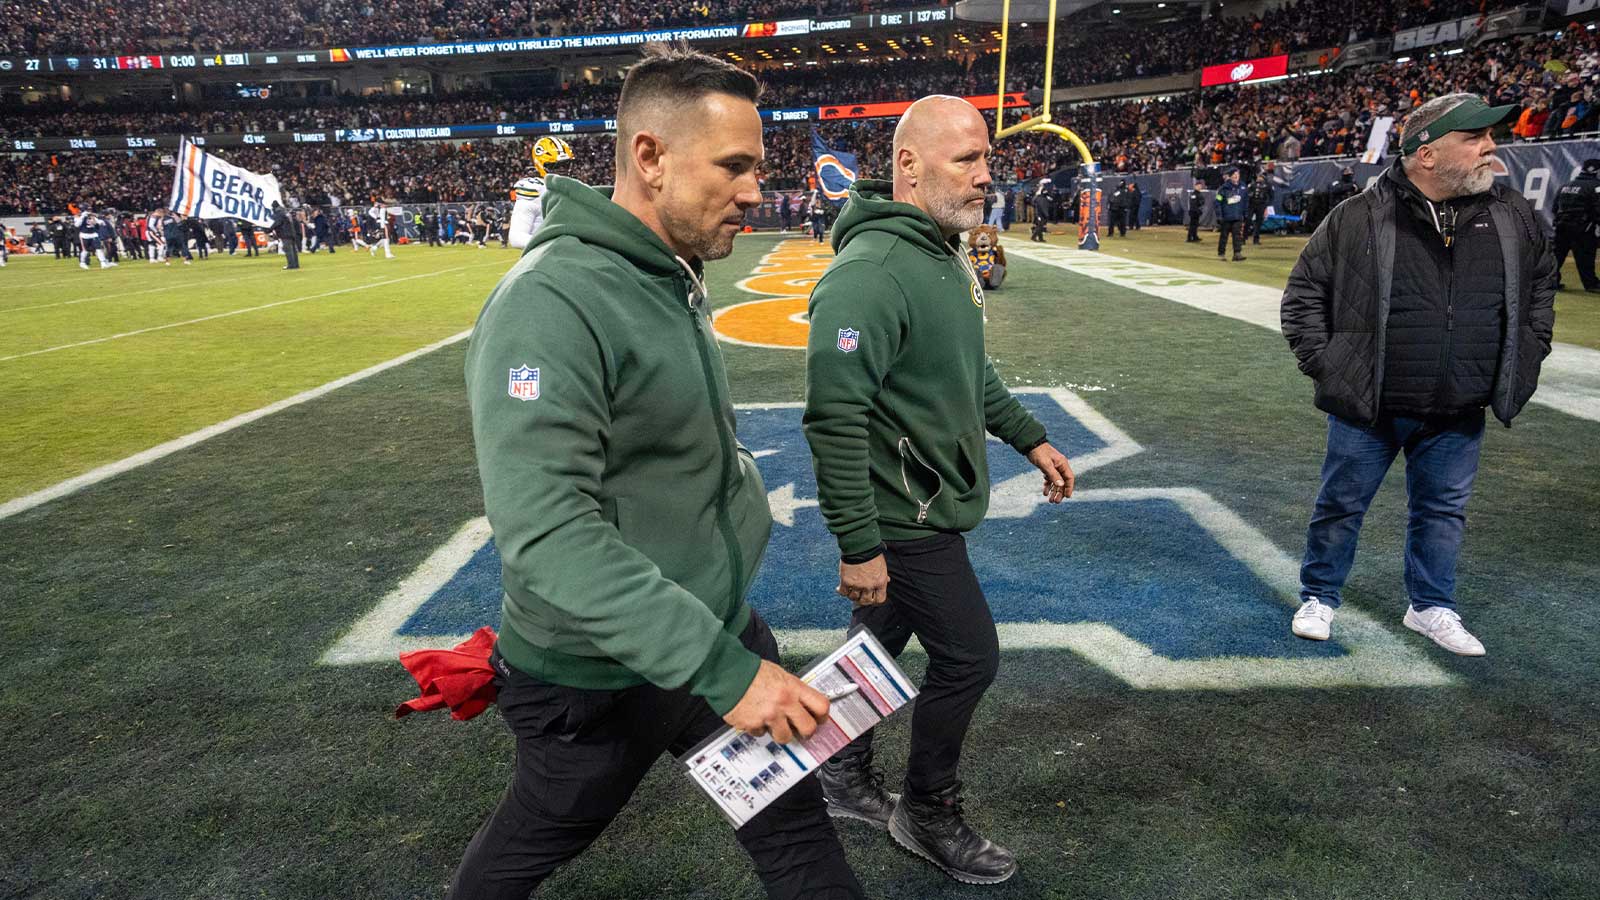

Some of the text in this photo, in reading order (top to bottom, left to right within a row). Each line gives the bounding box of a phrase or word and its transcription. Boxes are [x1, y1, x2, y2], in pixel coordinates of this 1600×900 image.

[881, 14, 902, 25] 8 REC
[917, 10, 946, 22] 137 YDS
[356, 49, 384, 59] WE'LL
[384, 47, 416, 57] NEVER
[417, 45, 454, 55] FORGET
[455, 44, 475, 53] THE
[475, 43, 495, 52] WAY
[497, 42, 516, 51] YOU
[518, 39, 562, 50] THRILLED
[563, 38, 582, 47] THE
[584, 36, 618, 45] NATION
[620, 33, 644, 44] WITH
[645, 32, 672, 42] YOUR
[673, 27, 737, 40] T-FORMATION
[25, 59, 40, 71] 27
[93, 57, 107, 69] 31
[170, 55, 196, 67] 0:00
[215, 54, 223, 65] 4
[229, 55, 240, 64] 40
[772, 110, 809, 120] 15 TARGETS
[496, 125, 516, 134] 8 REC
[549, 122, 574, 132] 137 YDS
[301, 133, 325, 142] TARGETS
[385, 128, 416, 139] COLSTON
[417, 127, 451, 138] LOVELAND
[69, 139, 83, 148] 124
[126, 137, 142, 147] 15.5
[242, 134, 254, 144] 43
[14, 140, 21, 150] 8
[211, 169, 264, 203] BEAR
[211, 191, 273, 223] DOWN
[839, 338, 856, 350] NFL
[513, 382, 537, 397] NFL
